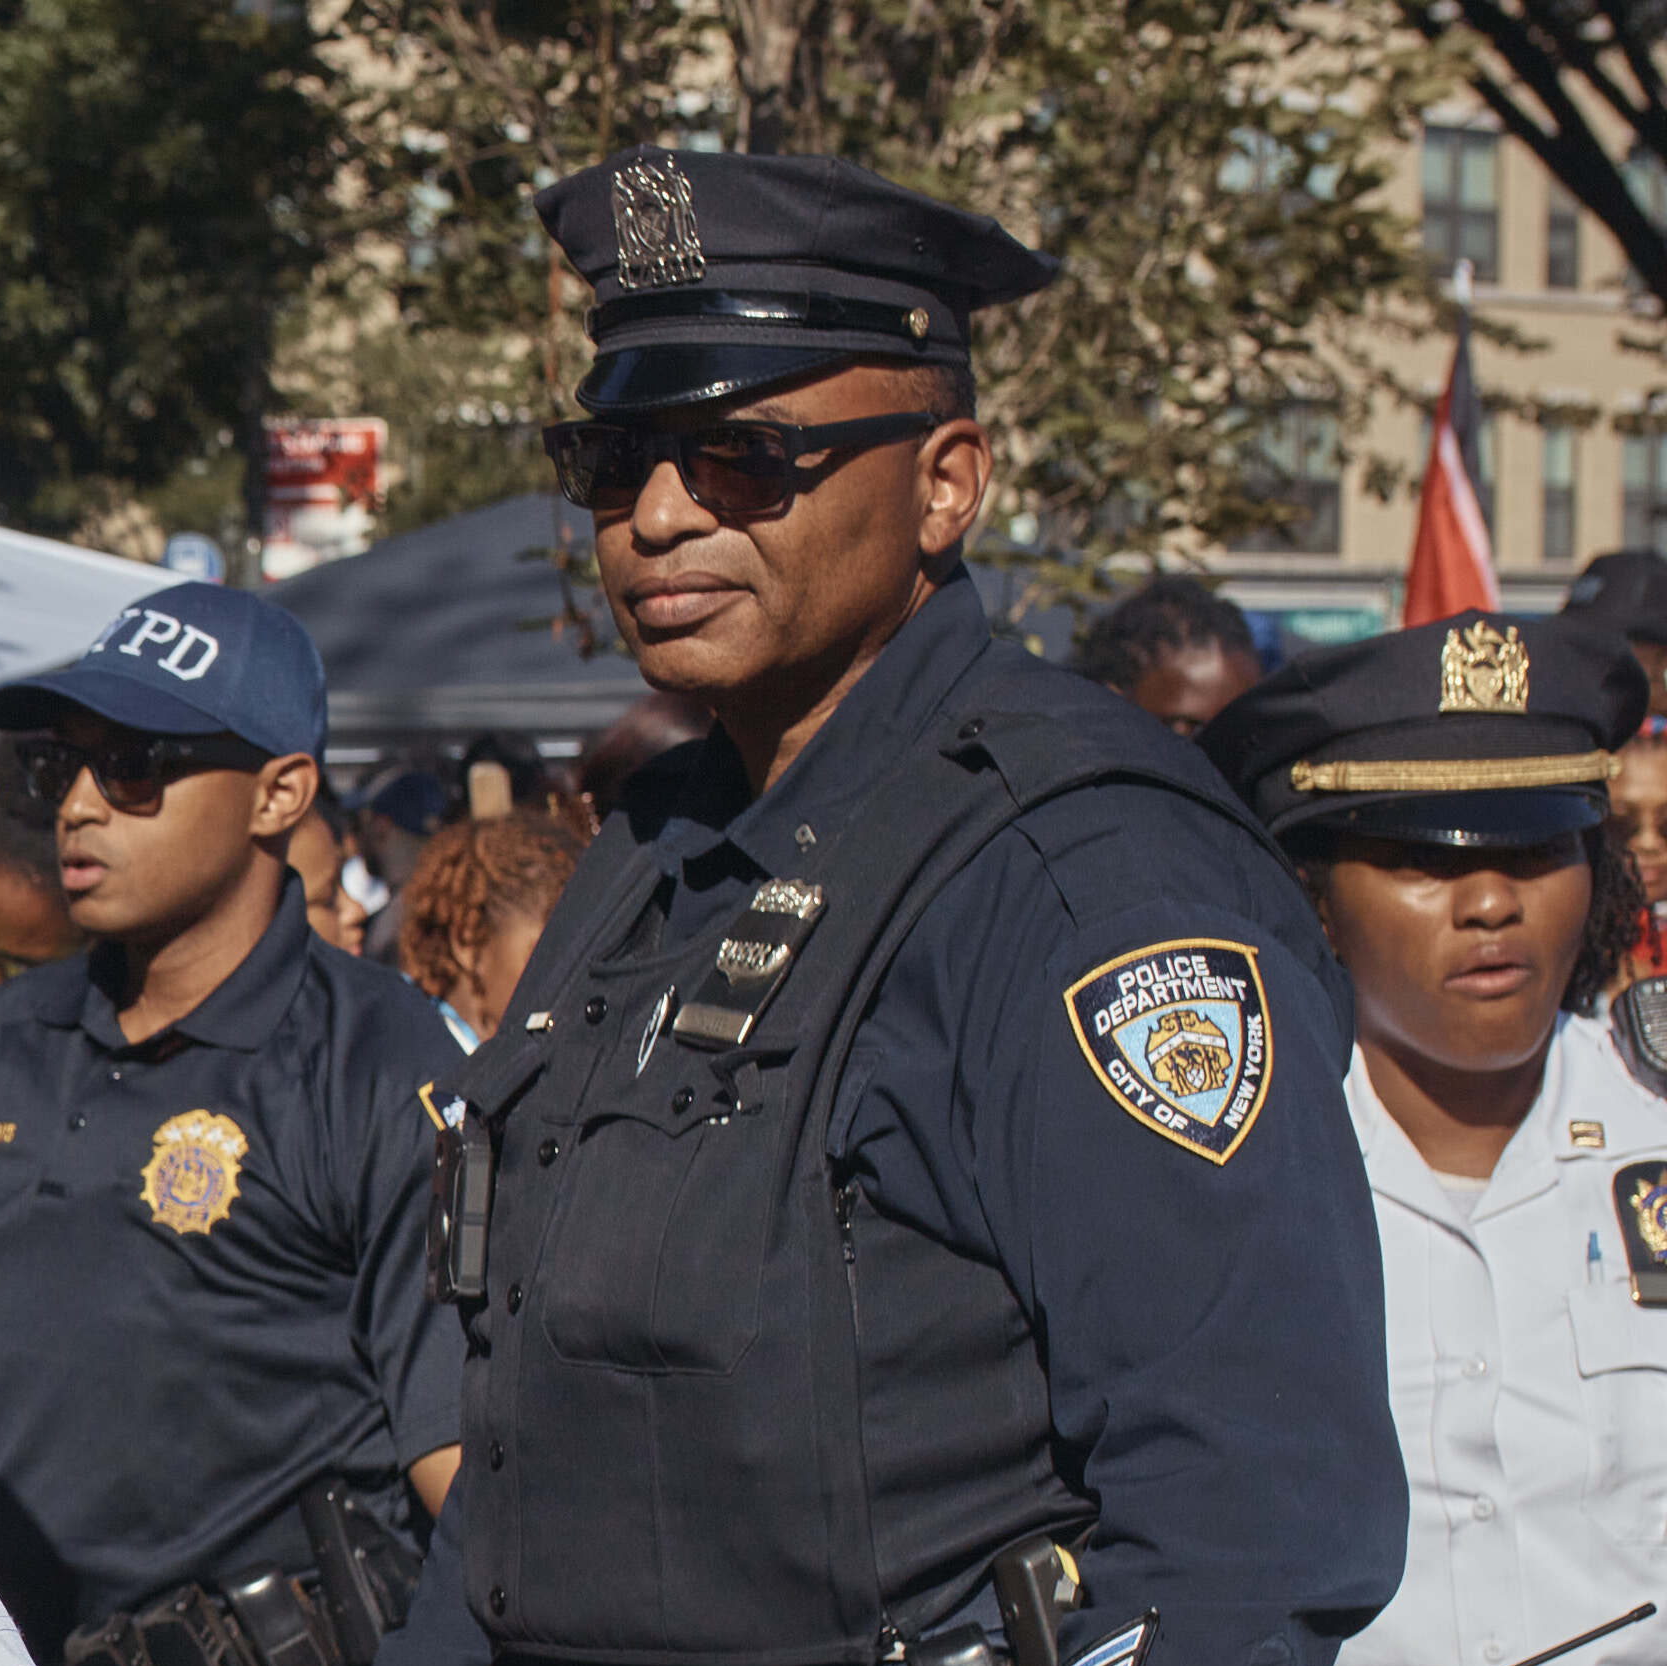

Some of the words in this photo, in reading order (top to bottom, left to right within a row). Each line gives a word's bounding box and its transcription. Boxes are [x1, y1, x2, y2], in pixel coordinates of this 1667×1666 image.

[1094, 976, 1247, 1036] DEPARTMENT
[1117, 955, 1210, 996] POLICE
[1107, 1058, 1155, 1108] CITY
[1153, 1103, 1189, 1131] OF
[1223, 1078, 1256, 1130] NEW
[1244, 1014, 1265, 1077] YORK
